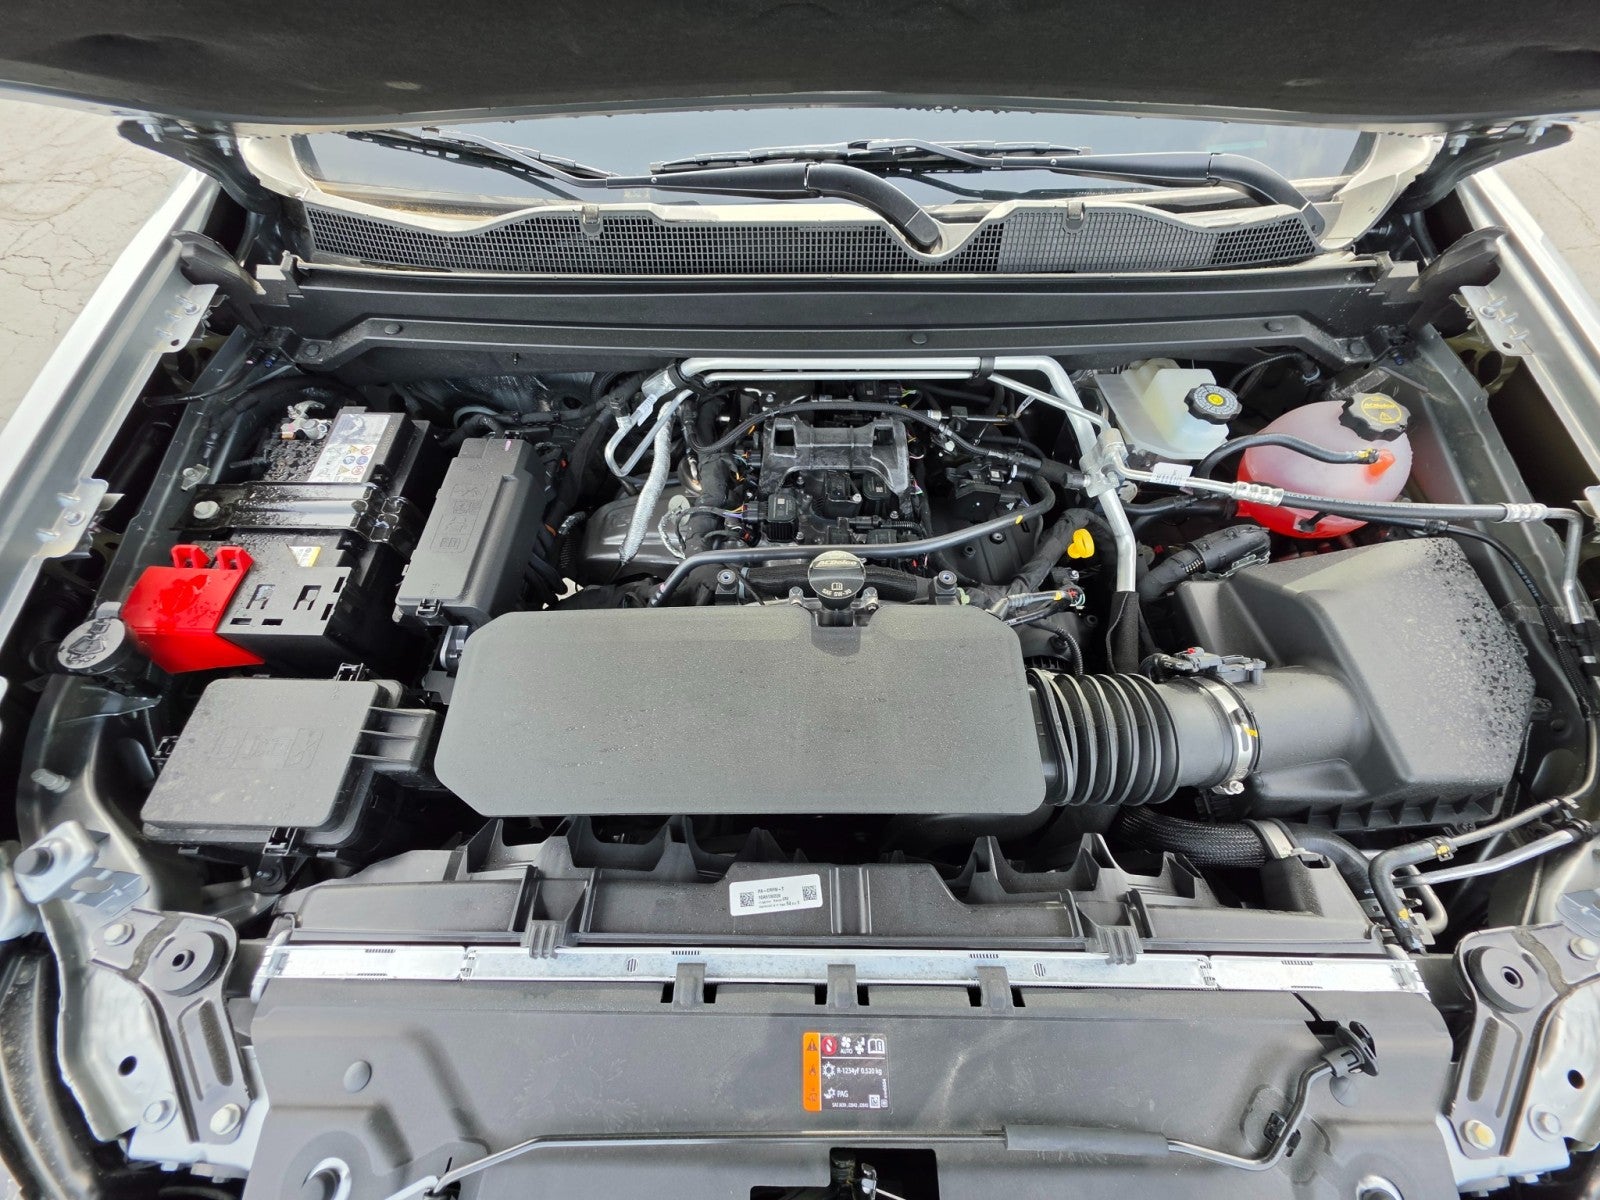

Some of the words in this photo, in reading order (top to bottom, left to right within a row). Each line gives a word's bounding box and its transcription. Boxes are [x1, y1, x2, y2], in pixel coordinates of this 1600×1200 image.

[836, 1067, 859, 1076] R-1234yf
[875, 1067, 882, 1076] kg
[837, 1090, 849, 1098] PAG
